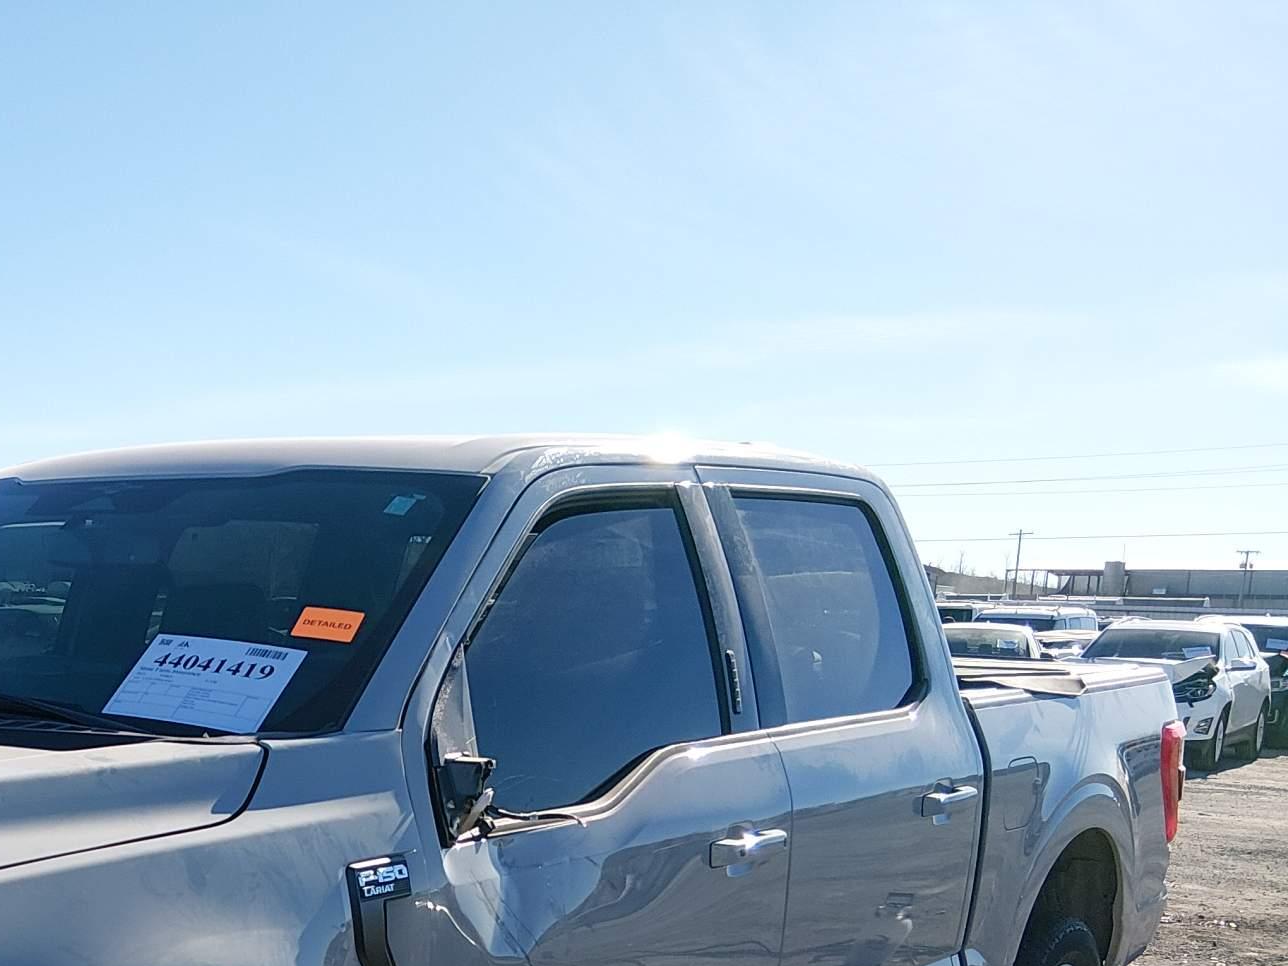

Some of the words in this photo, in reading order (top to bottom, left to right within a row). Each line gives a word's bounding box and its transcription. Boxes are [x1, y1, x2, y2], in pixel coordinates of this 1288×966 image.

[302, 618, 352, 630] DETAILED
[153, 652, 275, 681] 44041419
[357, 864, 409, 887] F-150
[362, 883, 395, 897] LARIAT
